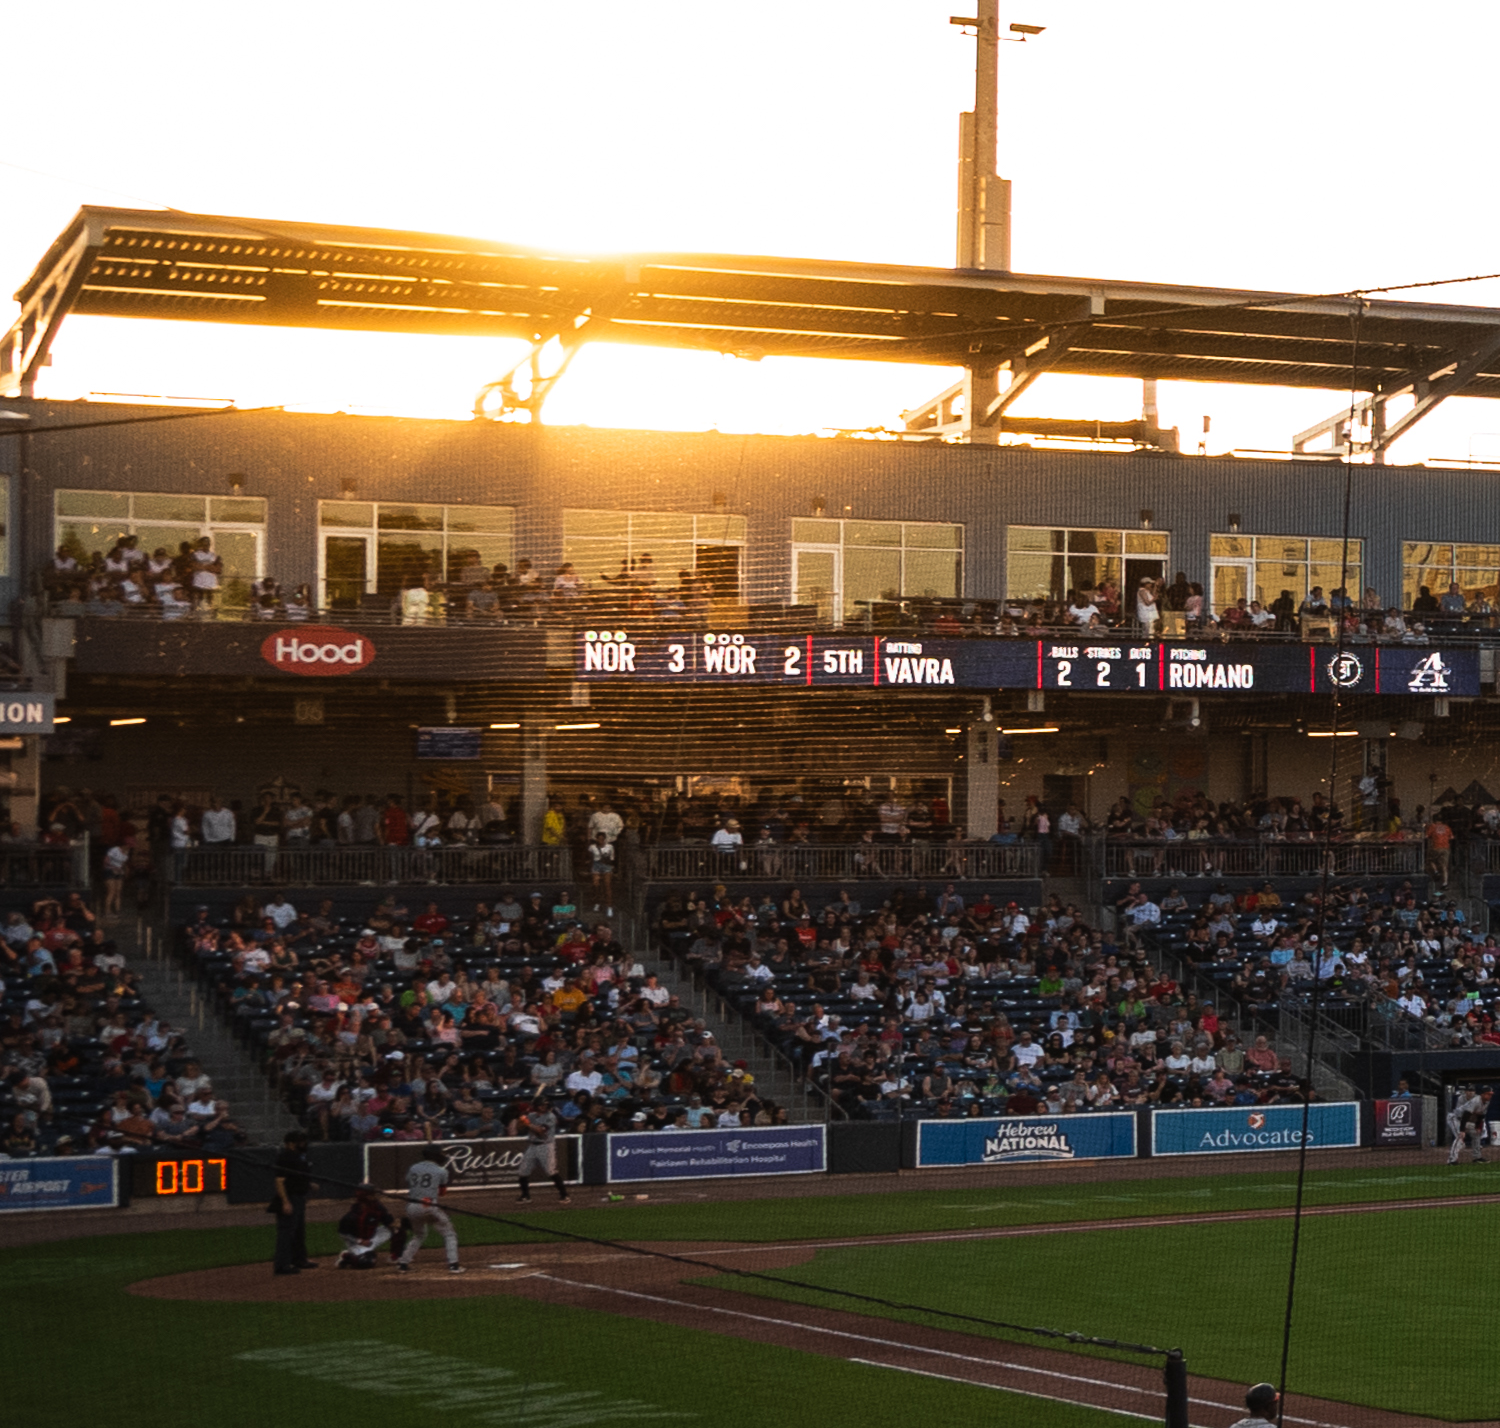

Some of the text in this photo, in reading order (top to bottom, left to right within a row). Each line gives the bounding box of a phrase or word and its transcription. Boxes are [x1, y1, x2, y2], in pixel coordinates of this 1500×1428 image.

[275, 637, 363, 664] Hood
[585, 644, 863, 675] NOR 3 WOR 2 5TH
[885, 658, 955, 685] VAVRA
[1057, 661, 1146, 687] 2 2 1
[1170, 664, 1254, 689] ROMANO
[997, 1122, 1058, 1137] Hebrew
[1199, 1127, 1315, 1148] Advocates
[742, 1138, 818, 1151] Encompass Health
[985, 1135, 1071, 1154] NATIONAL
[751, 1154, 786, 1165] Hospital
